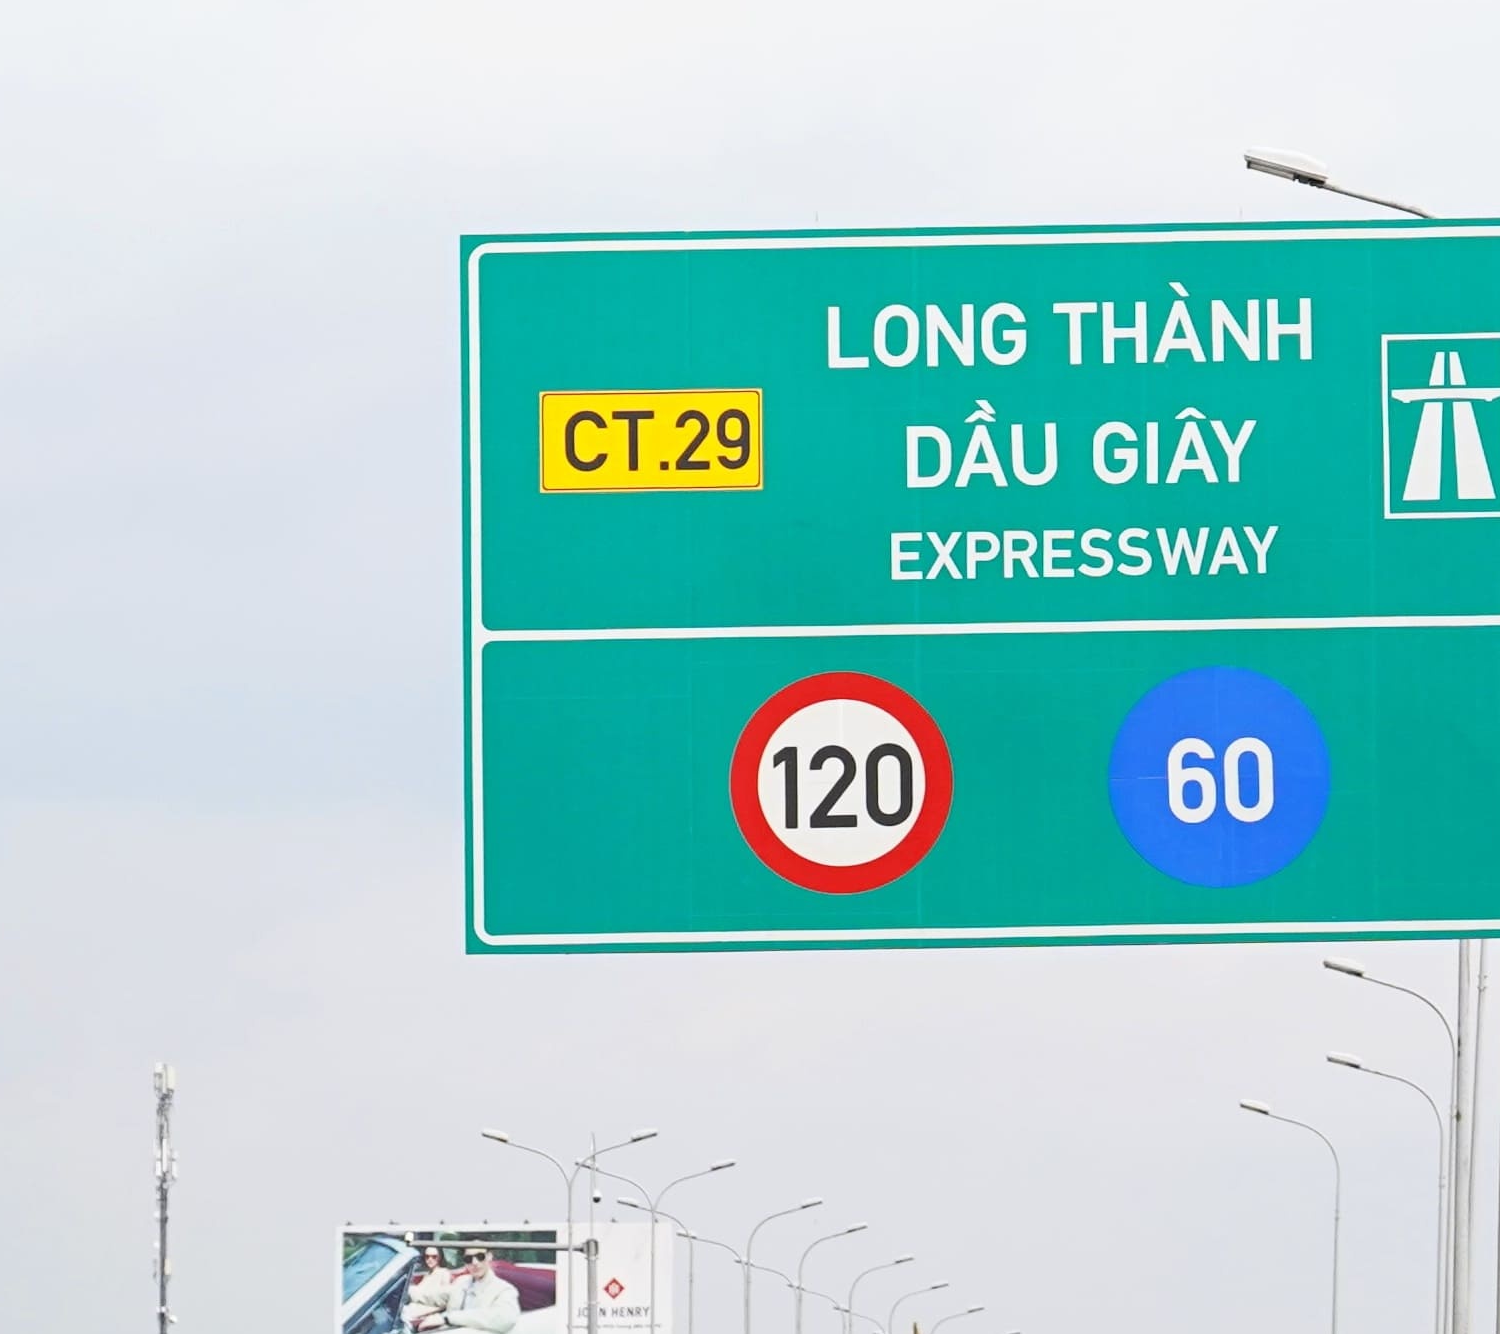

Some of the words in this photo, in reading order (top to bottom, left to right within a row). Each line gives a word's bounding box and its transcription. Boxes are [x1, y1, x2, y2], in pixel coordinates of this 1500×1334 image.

[828, 303, 1026, 368] LONG
[1053, 283, 1311, 364] THÀNH
[566, 410, 749, 471] CT.29
[907, 400, 1057, 487] DẦU
[1093, 408, 1256, 484] GIÂY
[892, 526, 1277, 579] EXPRESSWAY
[774, 744, 912, 828] 120
[1168, 738, 1273, 823] 60
[577, 1306, 607, 1318] JON
[611, 1306, 650, 1318] HENRY
